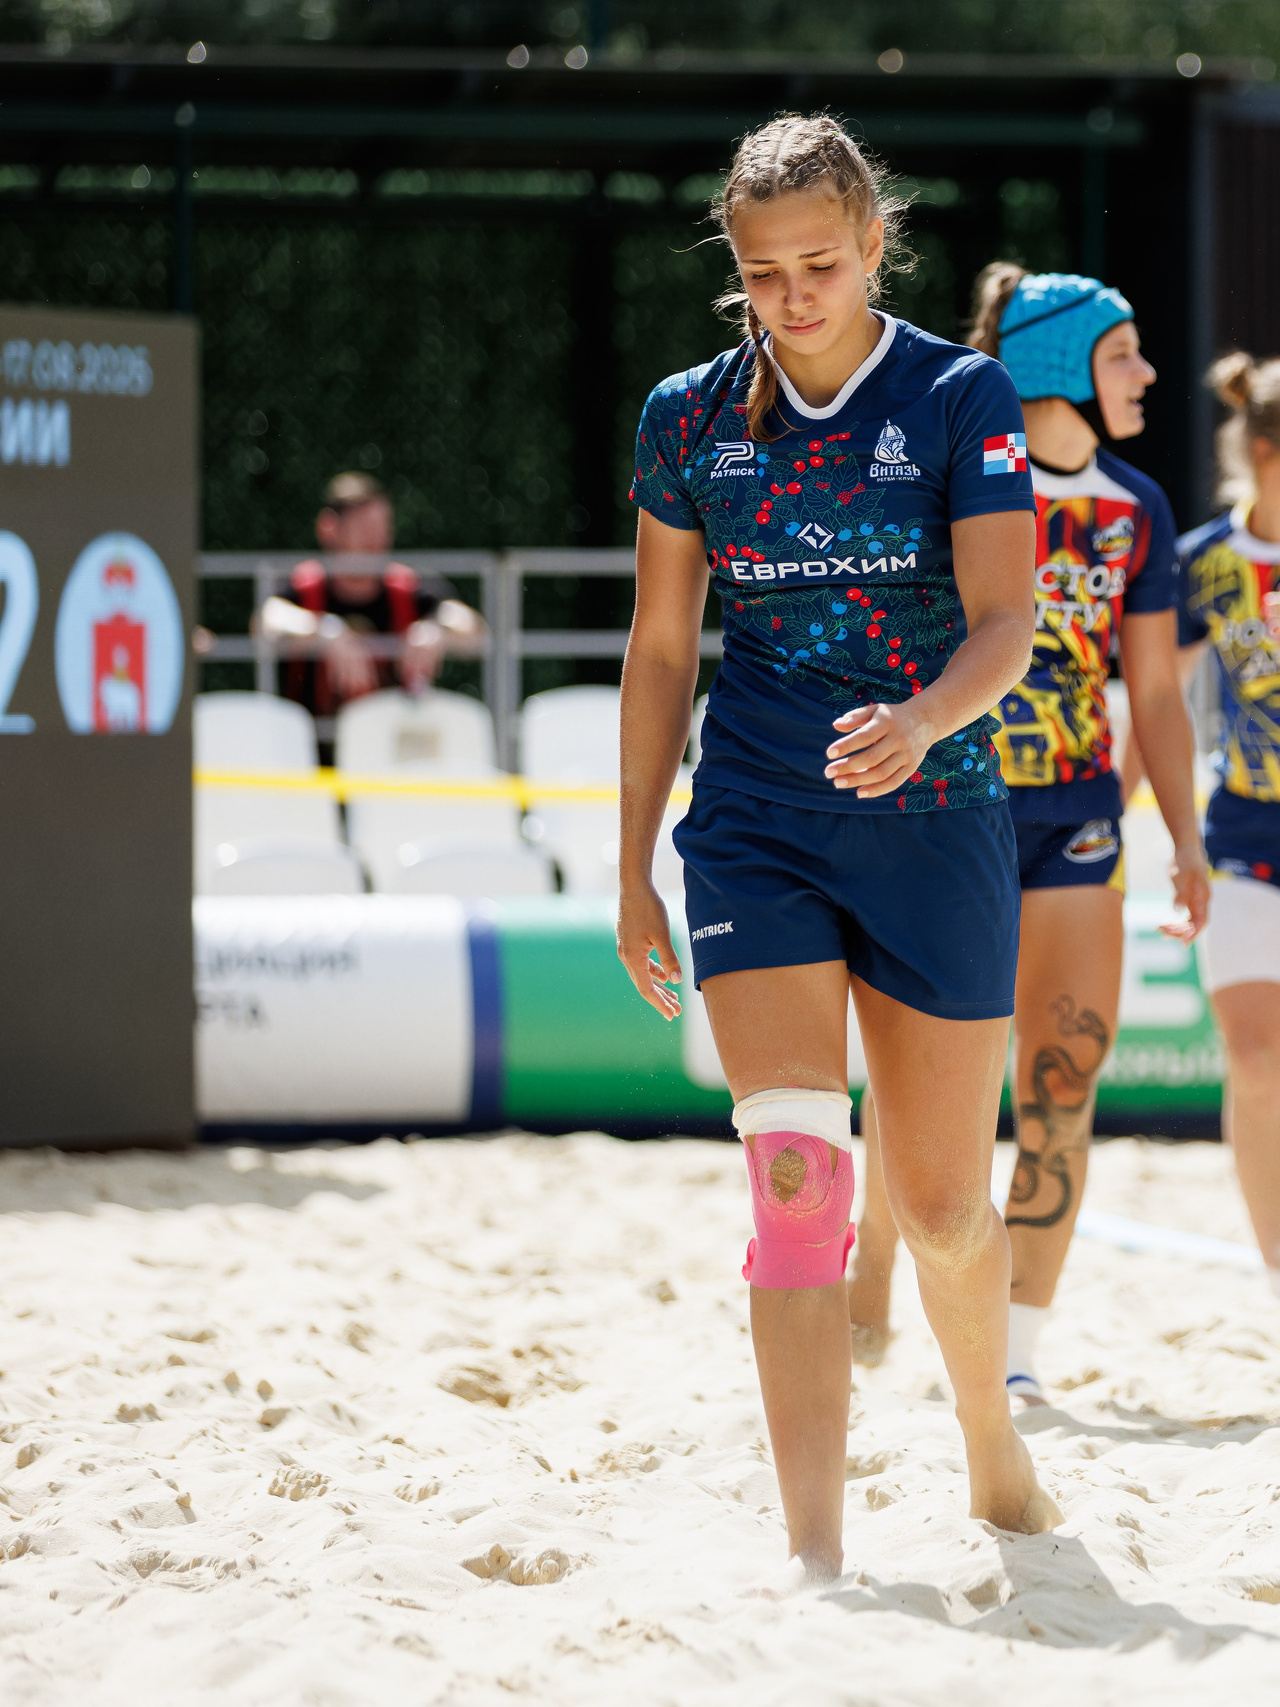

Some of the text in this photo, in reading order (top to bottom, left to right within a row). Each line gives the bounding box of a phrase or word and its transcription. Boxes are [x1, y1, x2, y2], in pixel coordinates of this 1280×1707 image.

[710, 467, 756, 480] PATRICK
[1034, 561, 1127, 599] СТОВ
[1035, 599, 1108, 633] ГТУ
[697, 921, 734, 941] PATRICK
